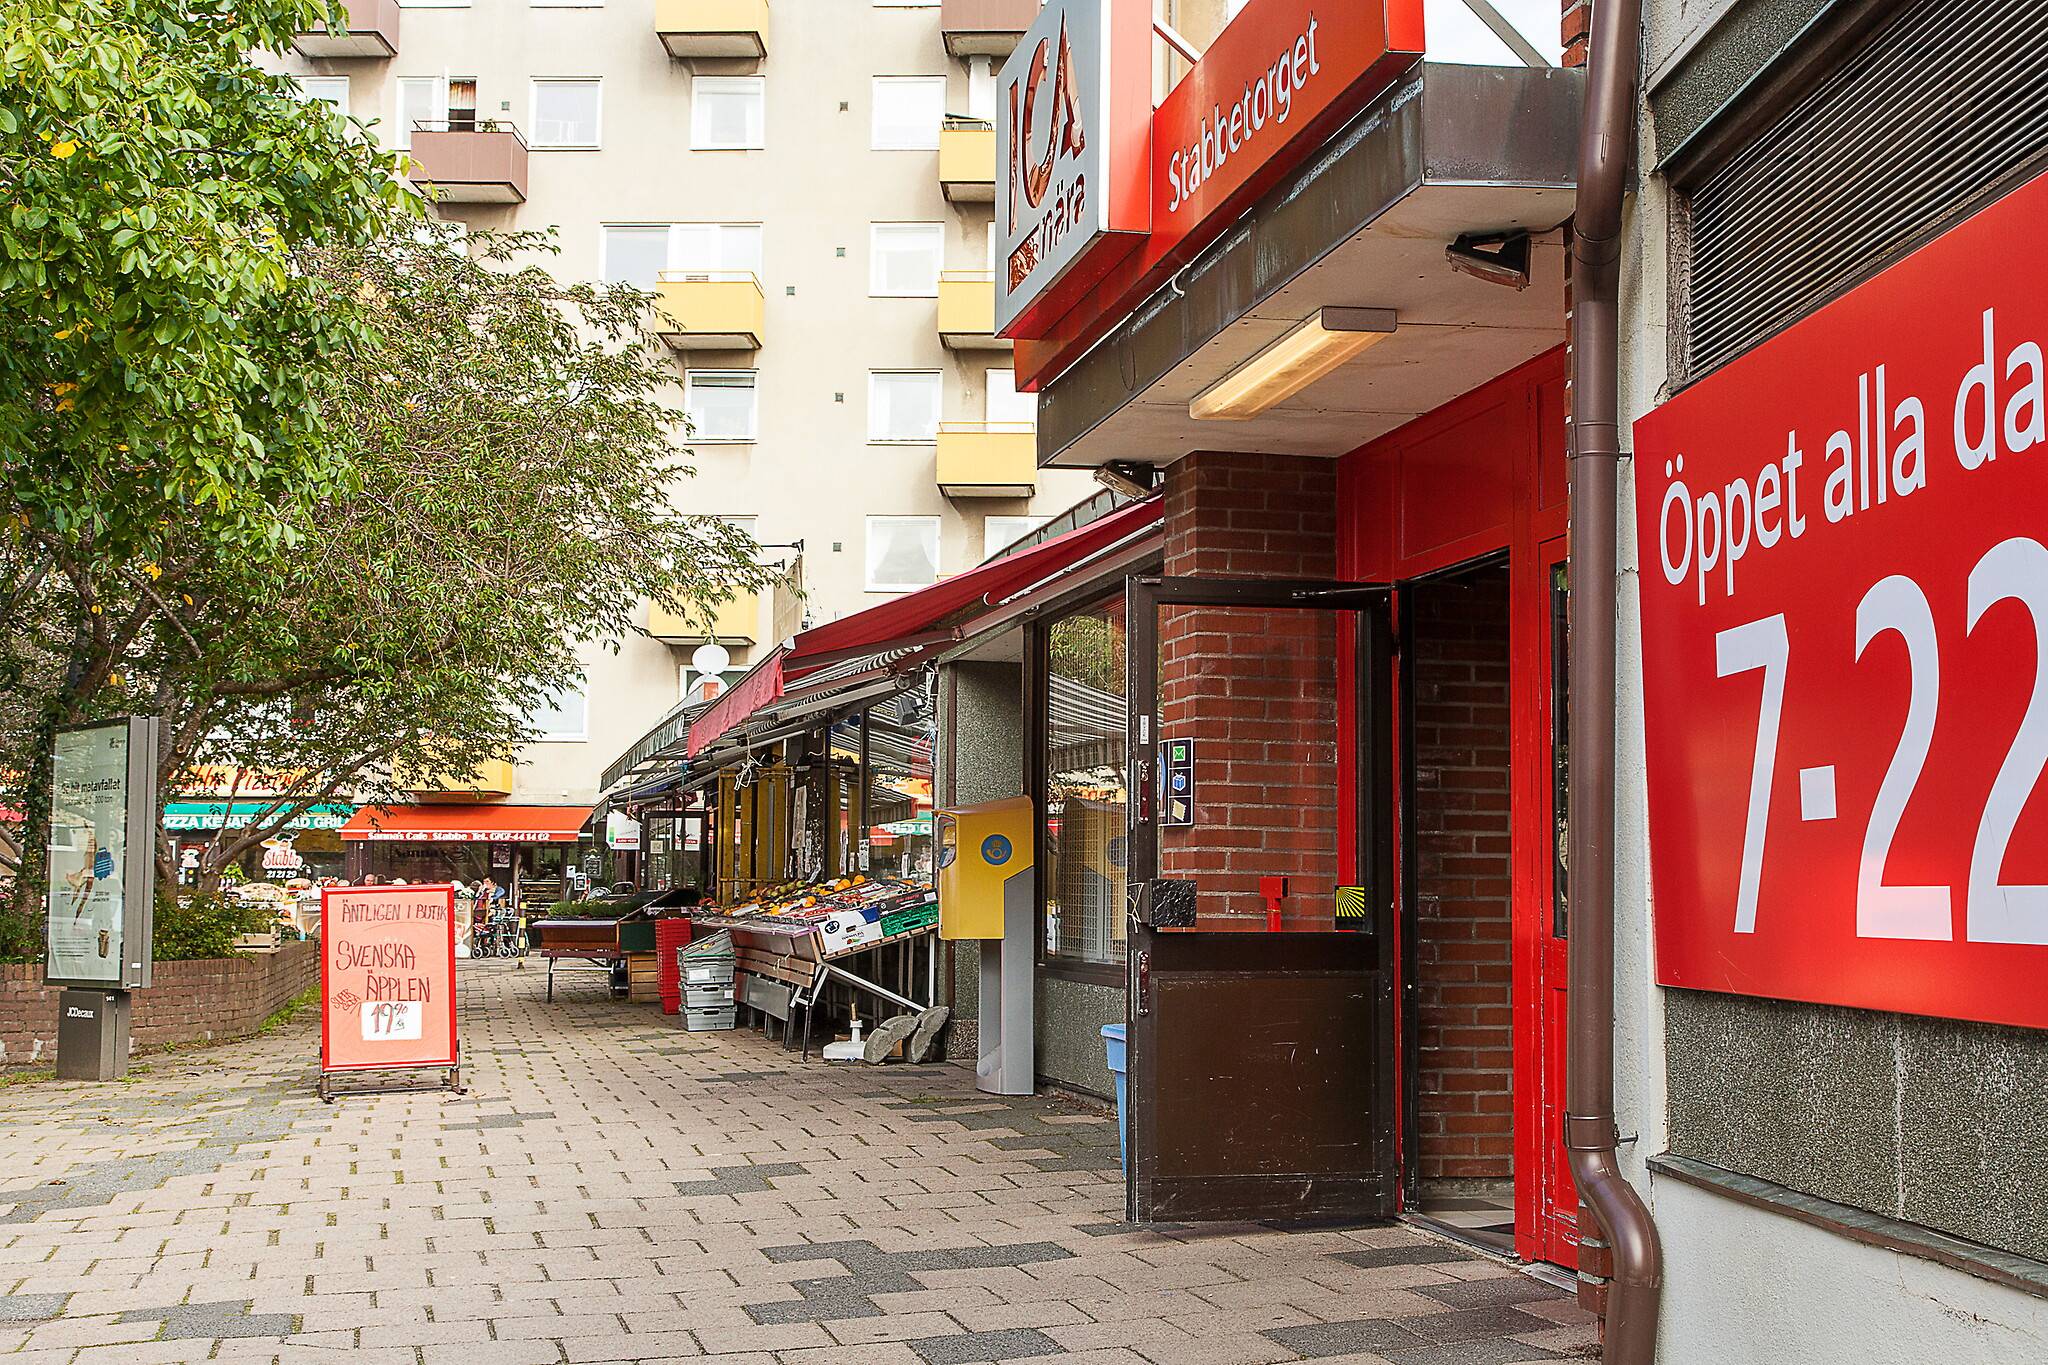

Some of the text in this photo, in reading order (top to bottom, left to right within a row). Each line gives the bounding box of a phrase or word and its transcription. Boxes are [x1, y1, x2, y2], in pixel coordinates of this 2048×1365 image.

[1008, 7, 1086, 238] ICA
[1168, 9, 1321, 213] Stabbetorget
[1039, 172, 1086, 261] nära
[1659, 429, 1807, 606] Öppet
[1823, 363, 1927, 525] alla
[1715, 536, 2048, 946] 7-22
[432, 831, 468, 841] Stabbe
[342, 899, 401, 922] ÄNTLIGEN
[416, 903, 448, 921] BUTIK
[336, 939, 416, 971] SVENSKA
[366, 969, 431, 1002] ÄPPLEN
[66, 1006, 94, 1019] JCDecaux
